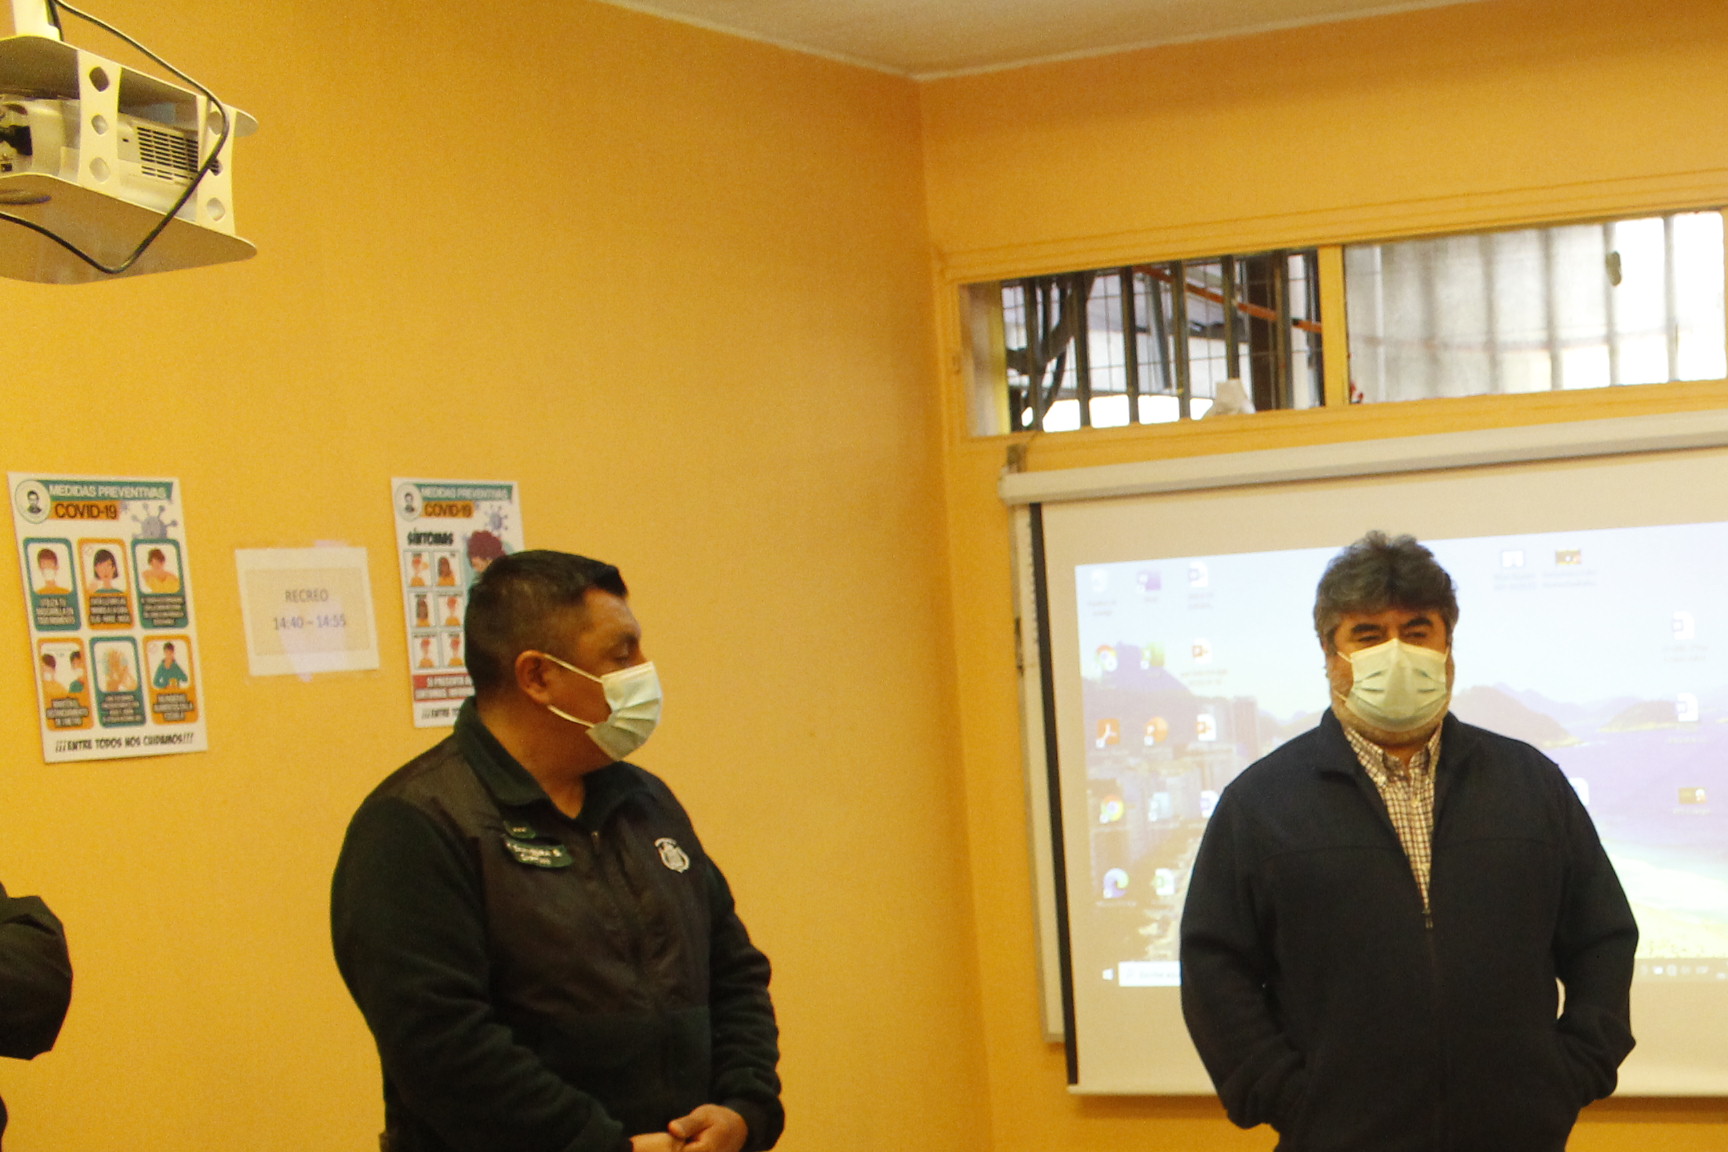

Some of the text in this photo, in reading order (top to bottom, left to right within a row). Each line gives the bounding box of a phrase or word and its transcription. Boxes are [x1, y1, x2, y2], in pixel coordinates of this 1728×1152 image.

[49, 484, 166, 499] MEDIDAS PREVENTIVAS
[54, 502, 117, 519] COVID-19
[424, 503, 472, 518] COVID-19
[284, 588, 329, 602] RECREO
[273, 615, 304, 631] 14:40
[316, 613, 347, 629] 14:55
[95, 737, 122, 750] TODOS
